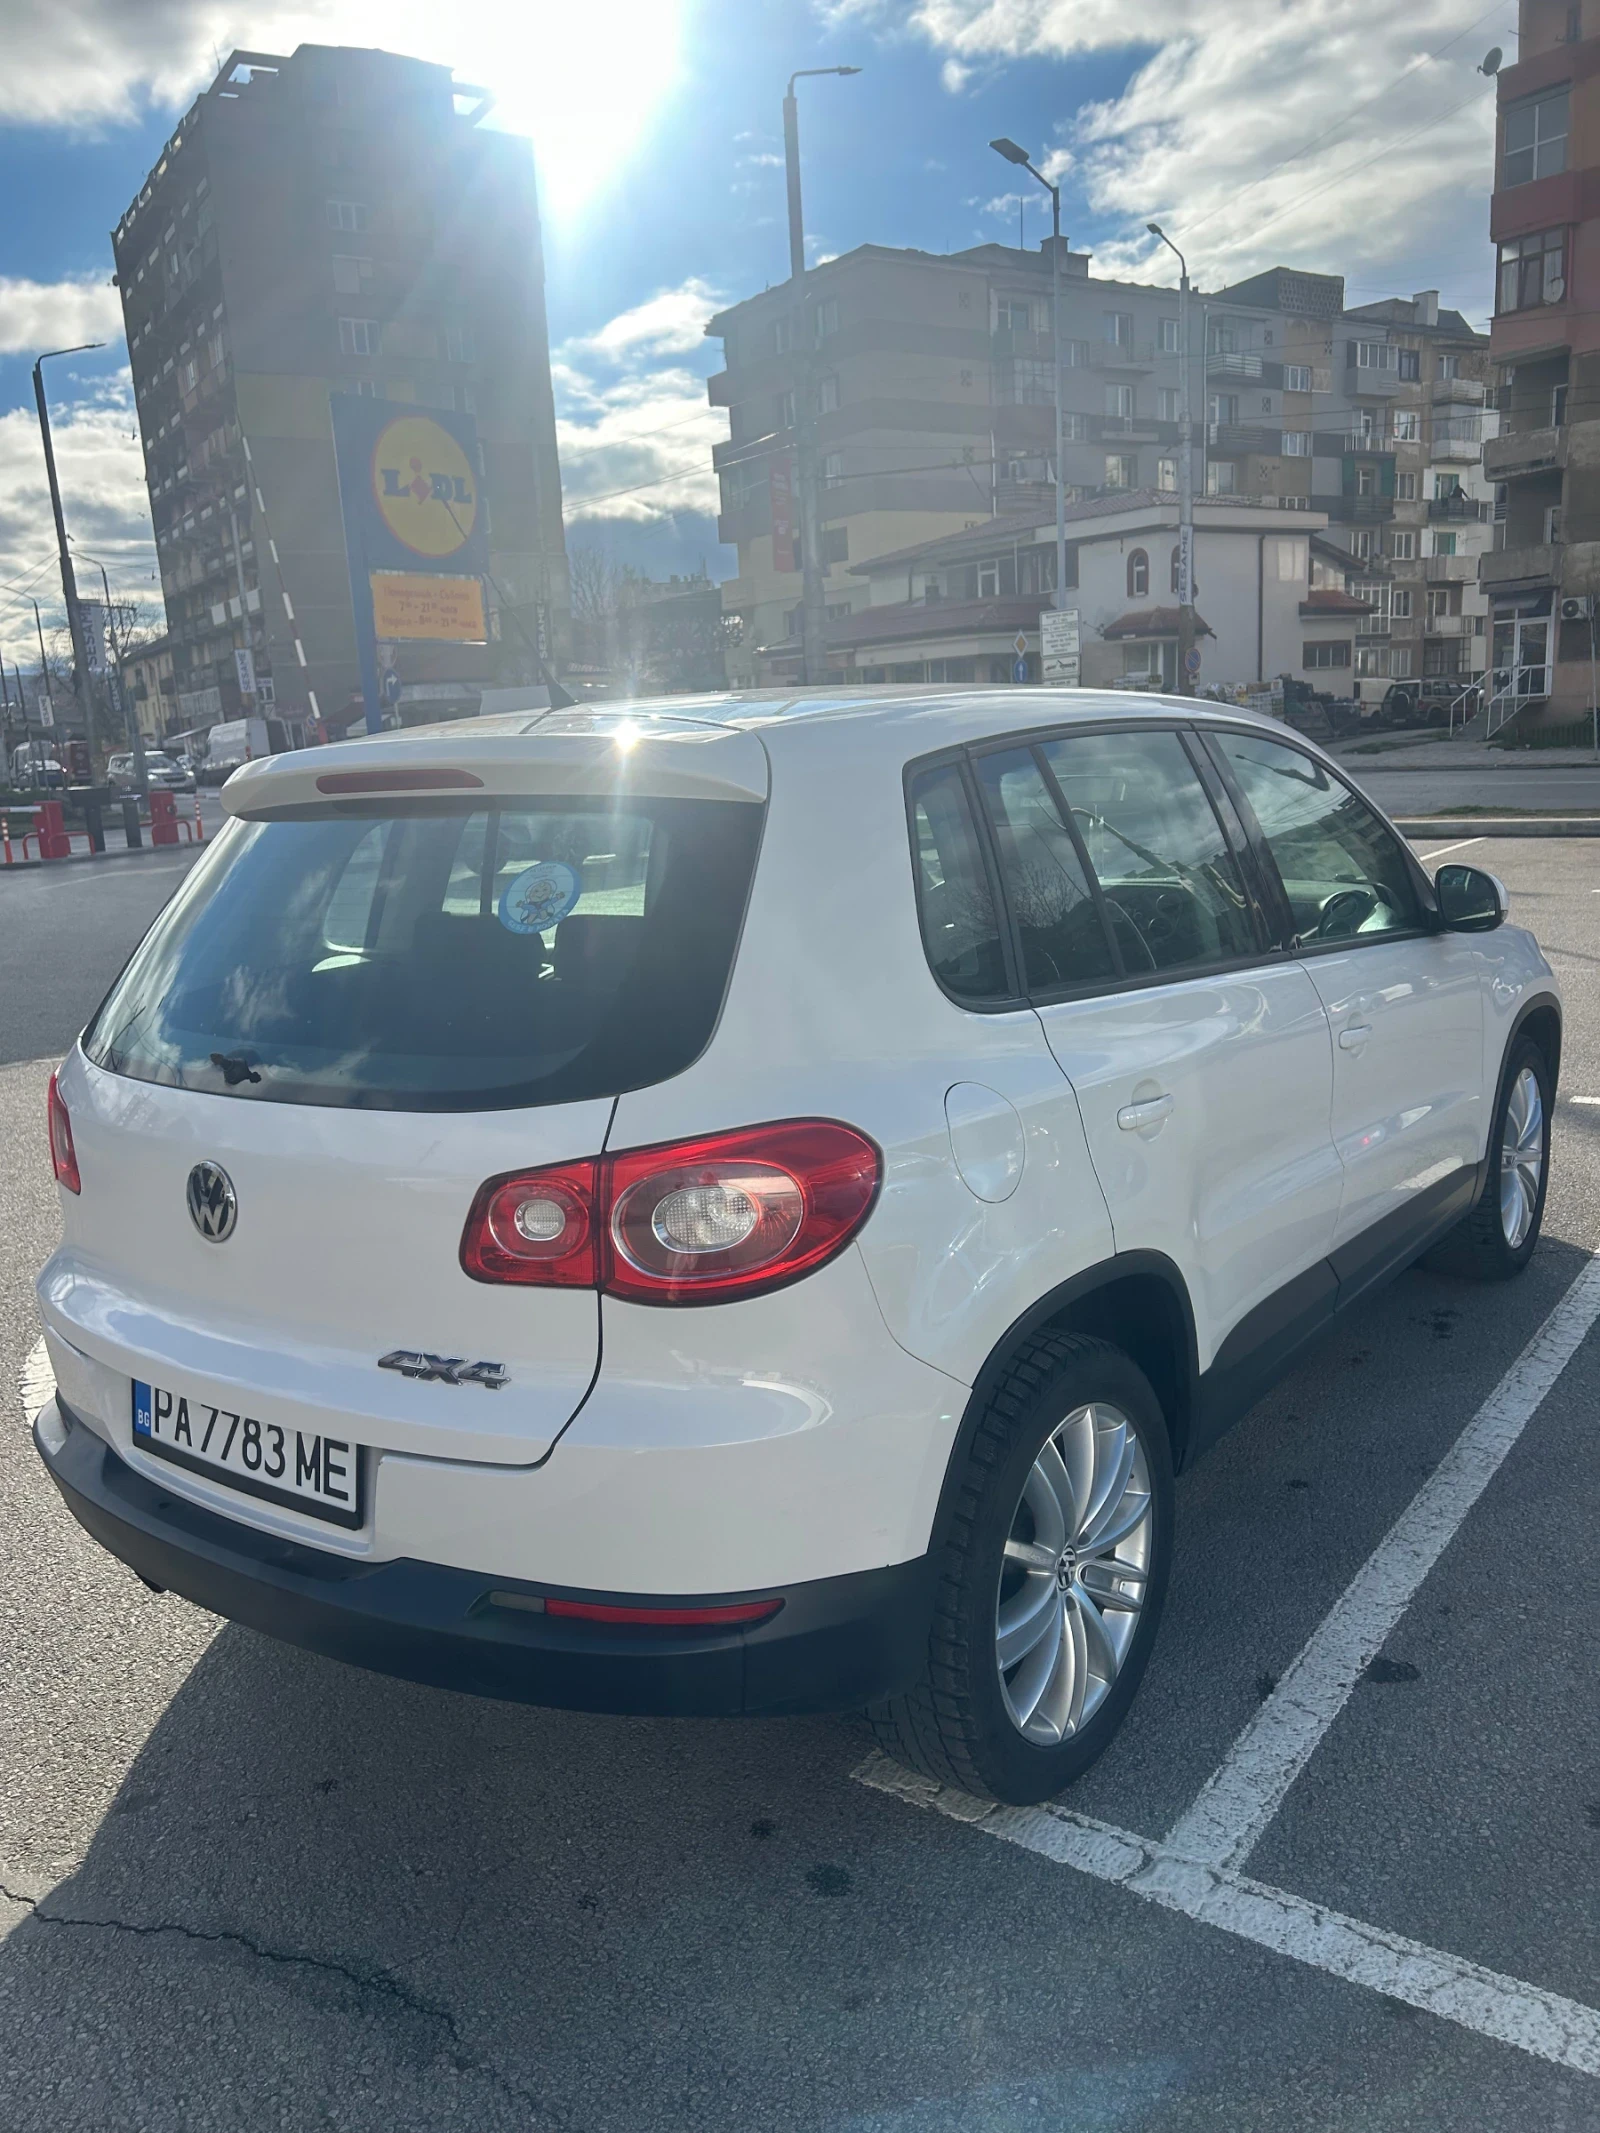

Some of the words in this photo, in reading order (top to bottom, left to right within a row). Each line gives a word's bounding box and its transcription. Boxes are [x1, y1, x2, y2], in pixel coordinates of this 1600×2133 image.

[1179, 530, 1189, 603] SESAME
[187, 1161, 238, 1242] VW
[137, 1408, 150, 1428] BG
[154, 1387, 193, 1447] PA
[200, 1404, 286, 1478] 7783
[295, 1431, 349, 1501] ME
